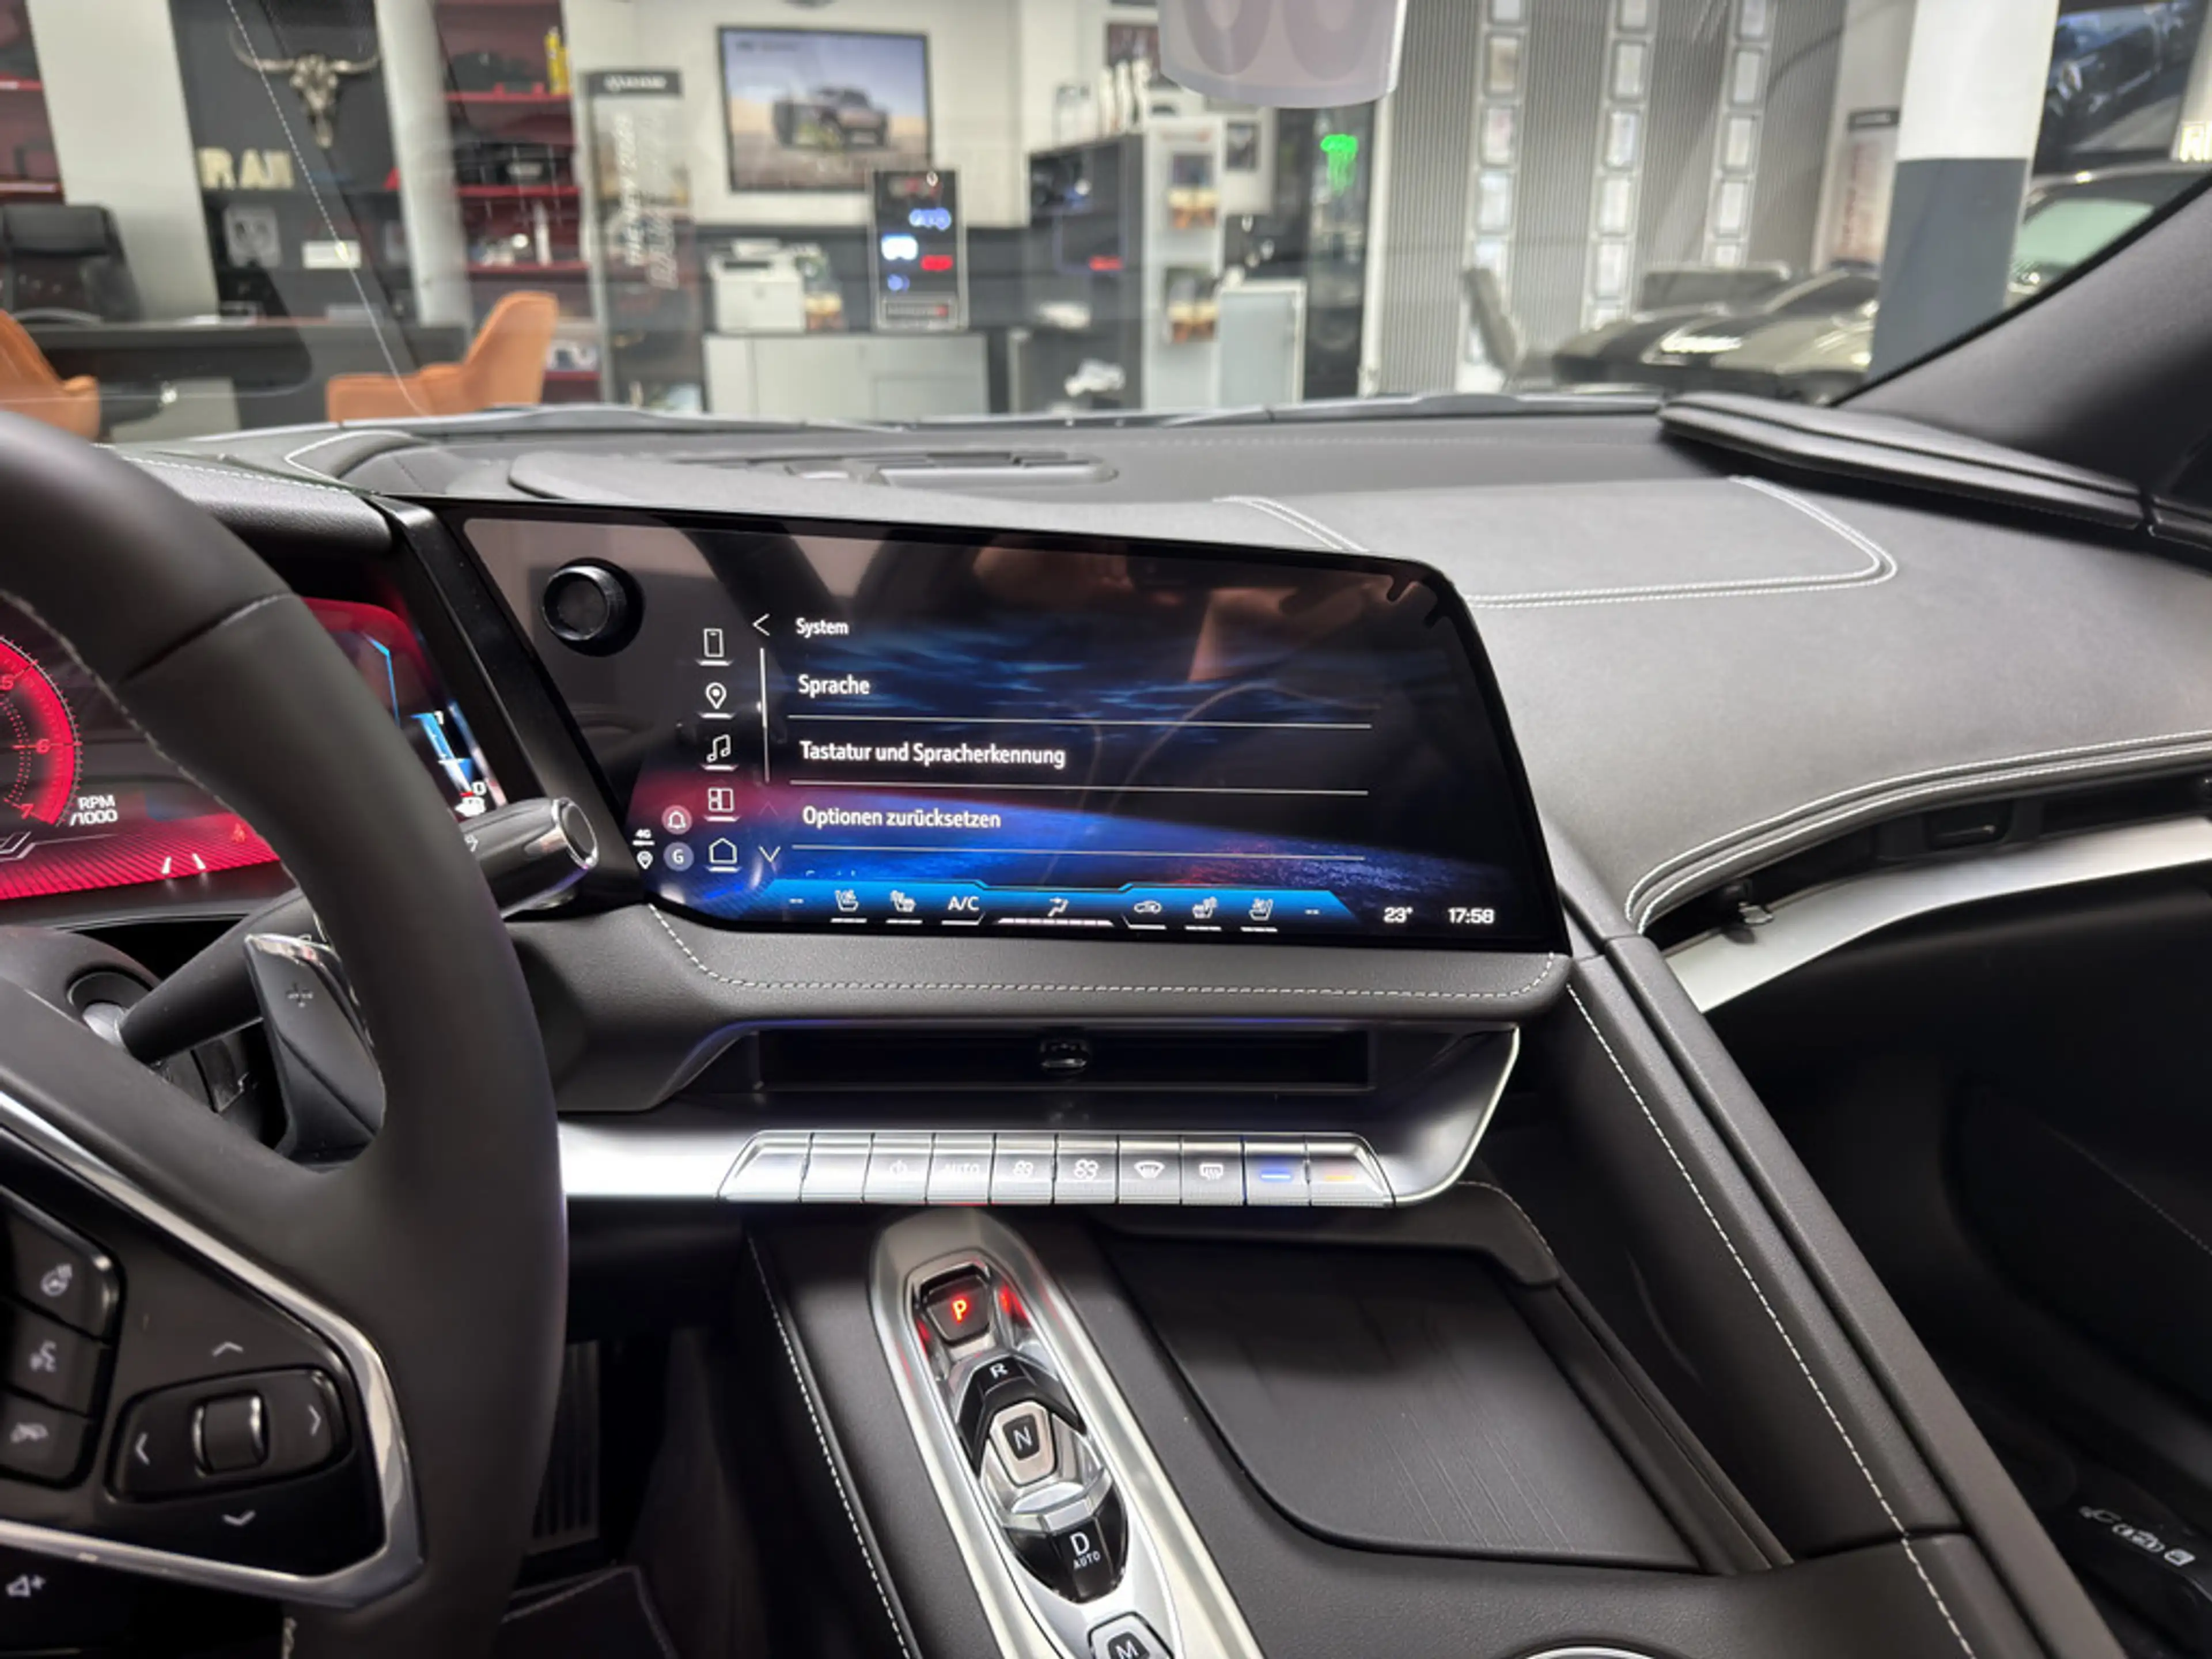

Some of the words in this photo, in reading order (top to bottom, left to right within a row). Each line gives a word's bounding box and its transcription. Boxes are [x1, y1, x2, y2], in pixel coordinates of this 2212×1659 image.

[796, 616, 850, 638] System
[798, 673, 870, 699] Sprache
[36, 738, 51, 754] 6
[799, 740, 872, 762] Tastatur
[875, 741, 909, 762] und
[912, 742, 1066, 770] Spracherkennung
[21, 804, 35, 820] 7
[78, 794, 115, 810] RPM
[802, 805, 882, 830] Optionen
[886, 808, 1001, 828] zurücksetzen
[948, 896, 980, 911] A/C
[1383, 906, 1414, 923] 23°
[1448, 907, 1495, 923] 17:58
[952, 1299, 967, 1320] P
[989, 1363, 1008, 1378] R
[1013, 1426, 1032, 1451] N
[1069, 1531, 1090, 1556] D
[1073, 1550, 1101, 1571] AUTO
[1116, 1639, 1139, 1659] M
